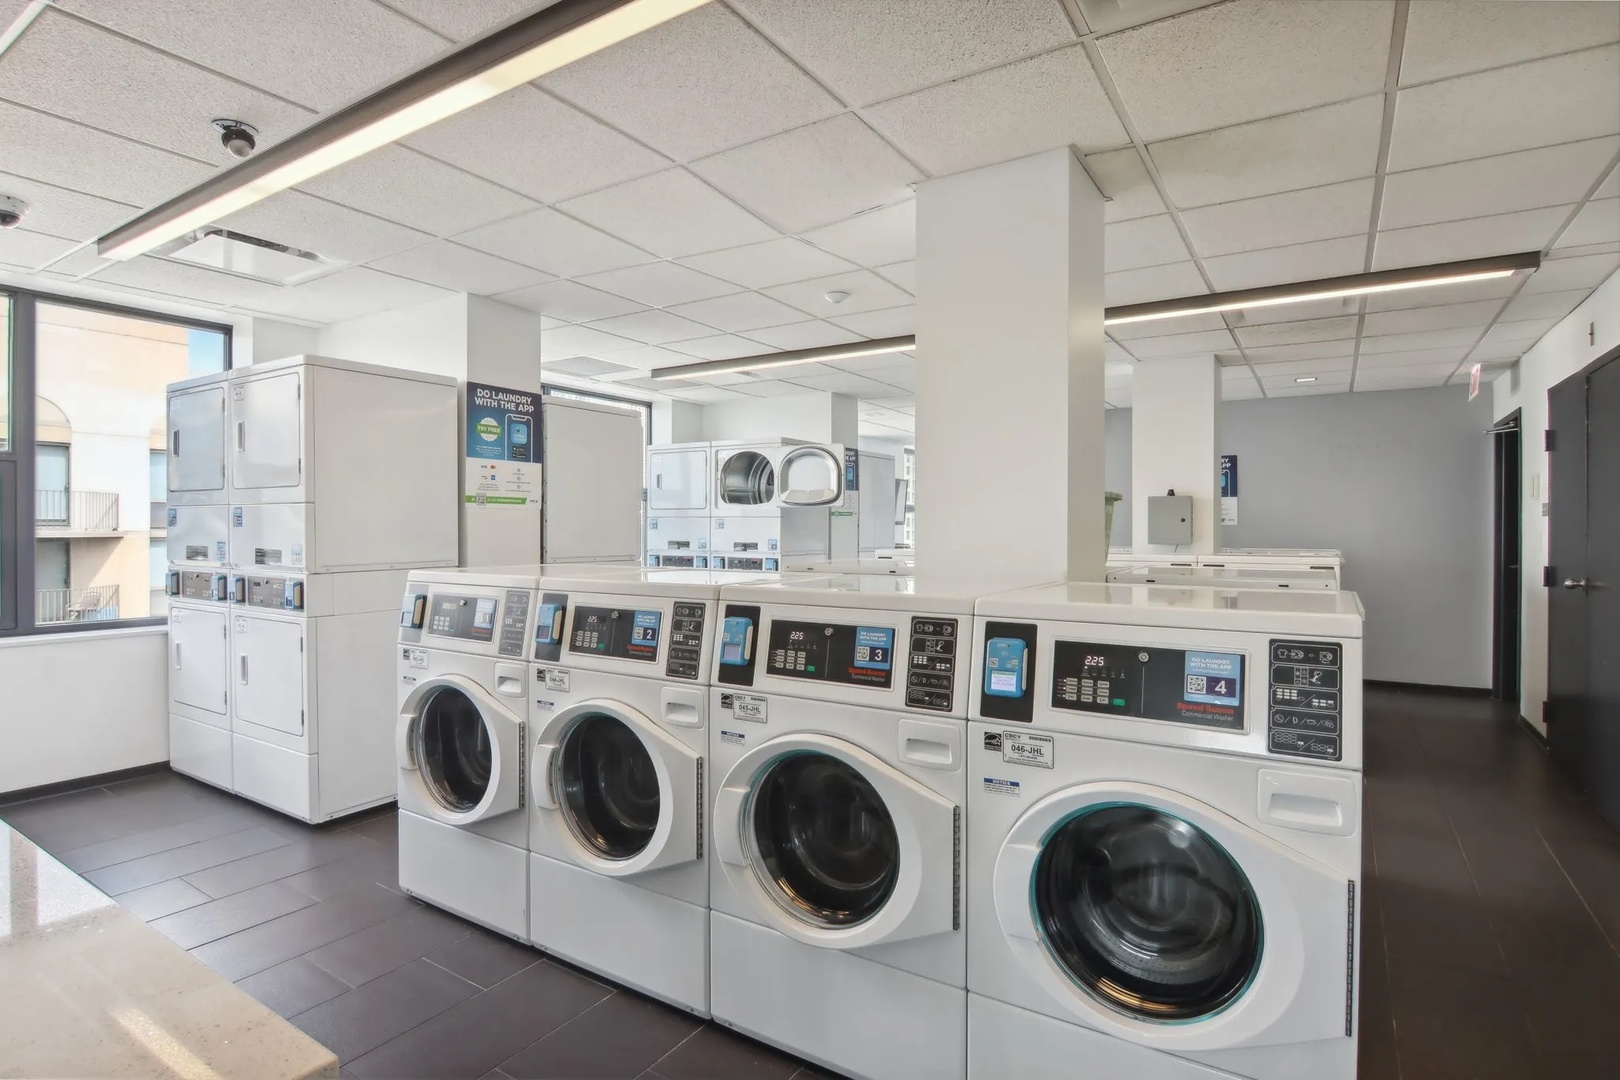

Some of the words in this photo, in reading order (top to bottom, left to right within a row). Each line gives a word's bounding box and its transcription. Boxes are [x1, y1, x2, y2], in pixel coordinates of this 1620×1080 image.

[477, 388, 490, 398] DO
[492, 391, 532, 405] LAUNDRY
[474, 397, 498, 408] WITH
[500, 401, 516, 410] THE
[646, 630, 652, 639] 2
[874, 649, 882, 661] 3
[1215, 680, 1227, 694] 4
[1176, 702, 1204, 710] Speed
[1206, 705, 1234, 714] Queen
[1182, 710, 1212, 719] Commercial
[1011, 744, 1044, 755] 046-JHL
